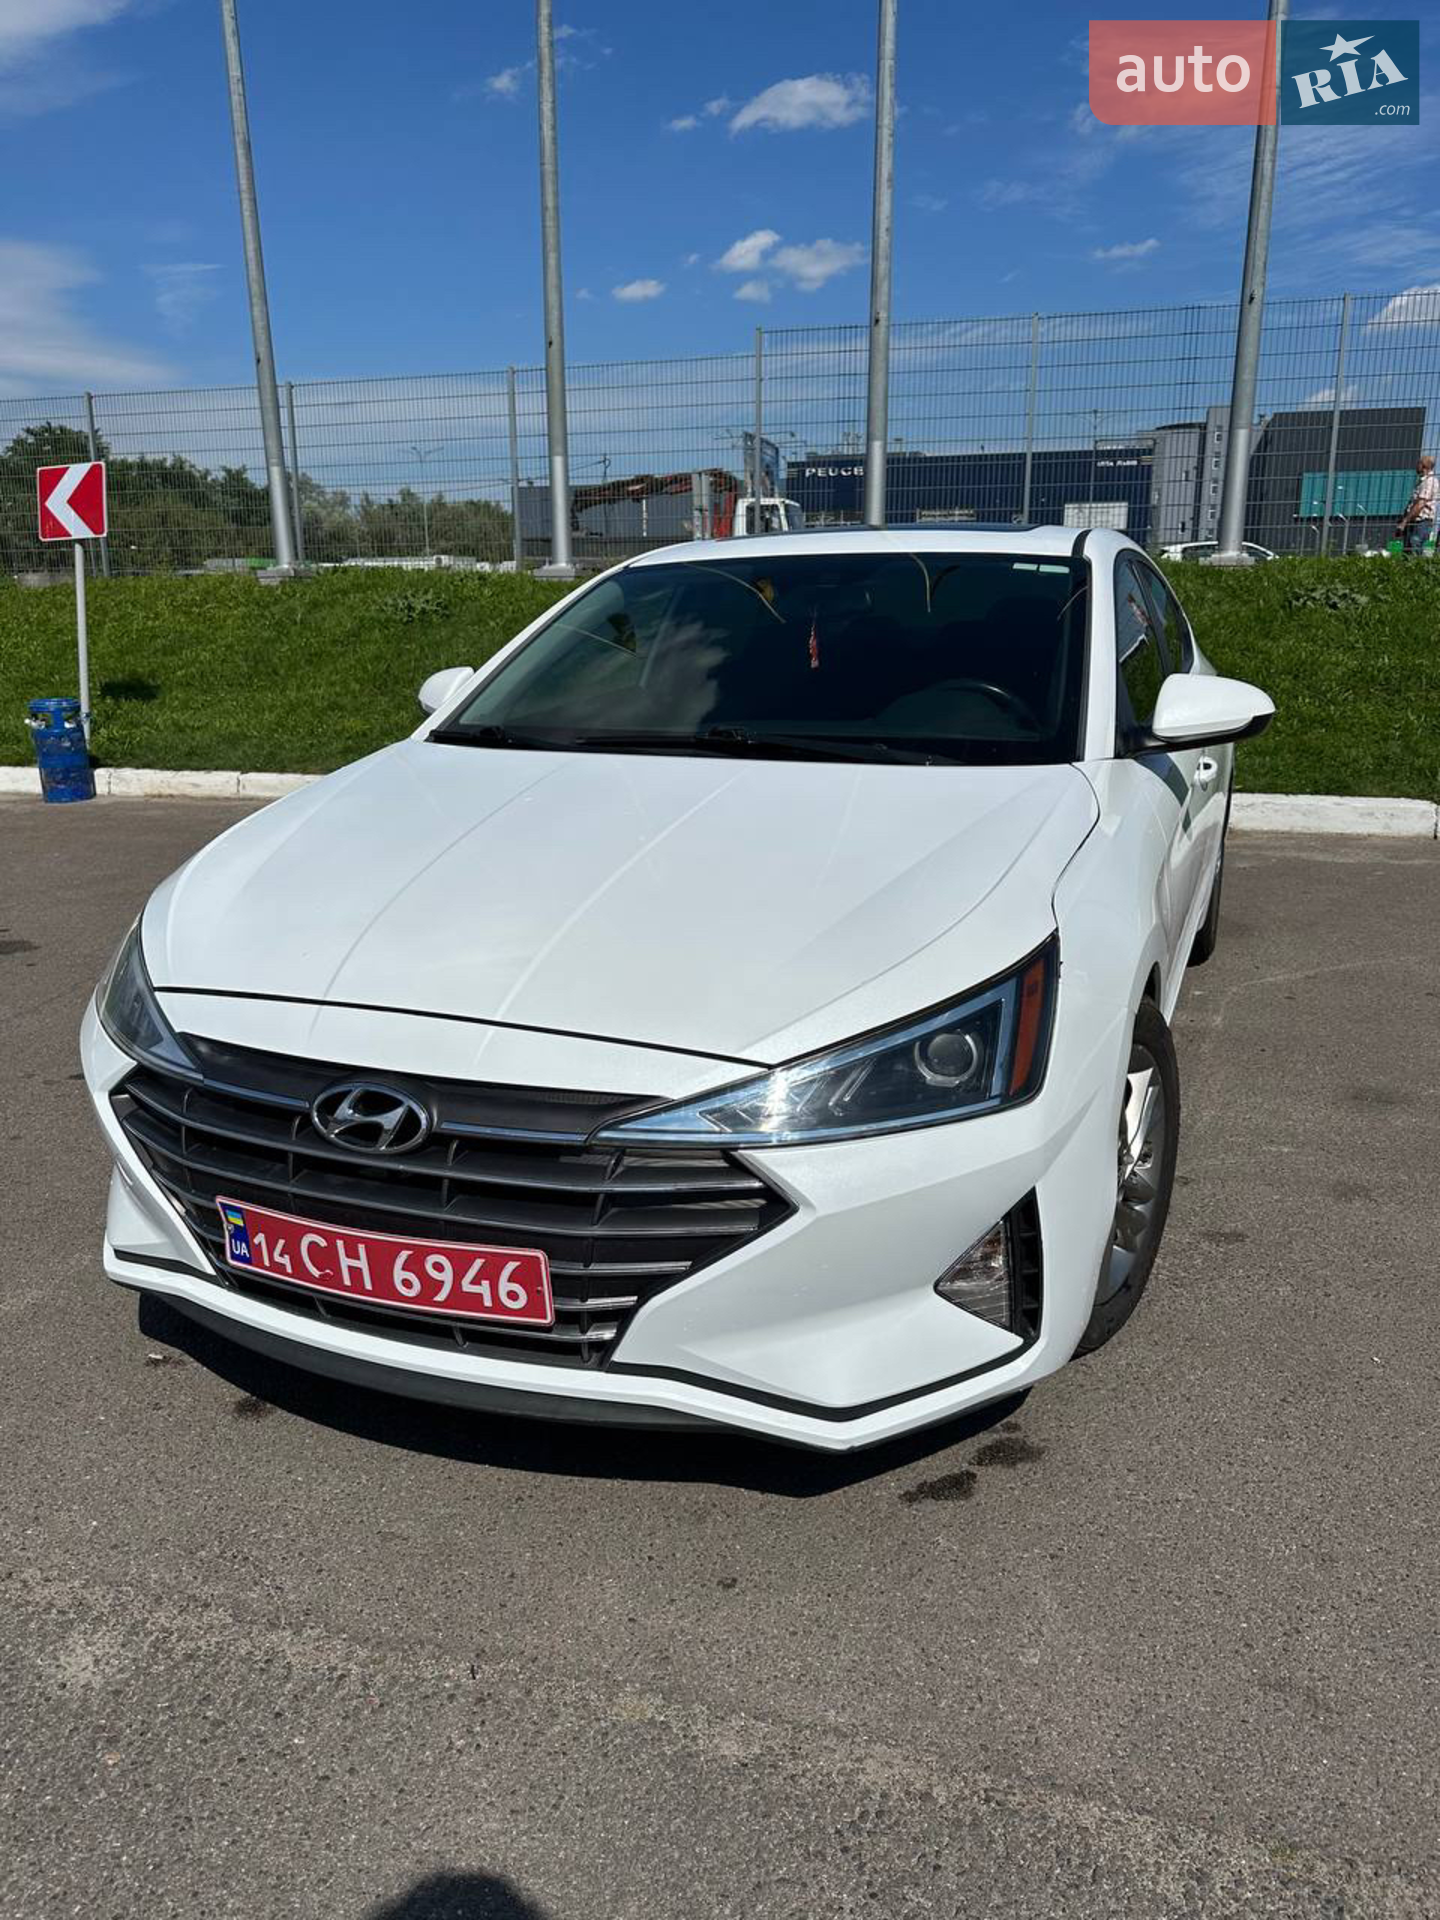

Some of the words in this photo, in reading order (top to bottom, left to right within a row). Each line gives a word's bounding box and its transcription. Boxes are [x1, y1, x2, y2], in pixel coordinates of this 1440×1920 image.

[805, 465, 865, 478] PEUGE
[231, 1238, 250, 1258] UA
[392, 1250, 528, 1310] 6946
